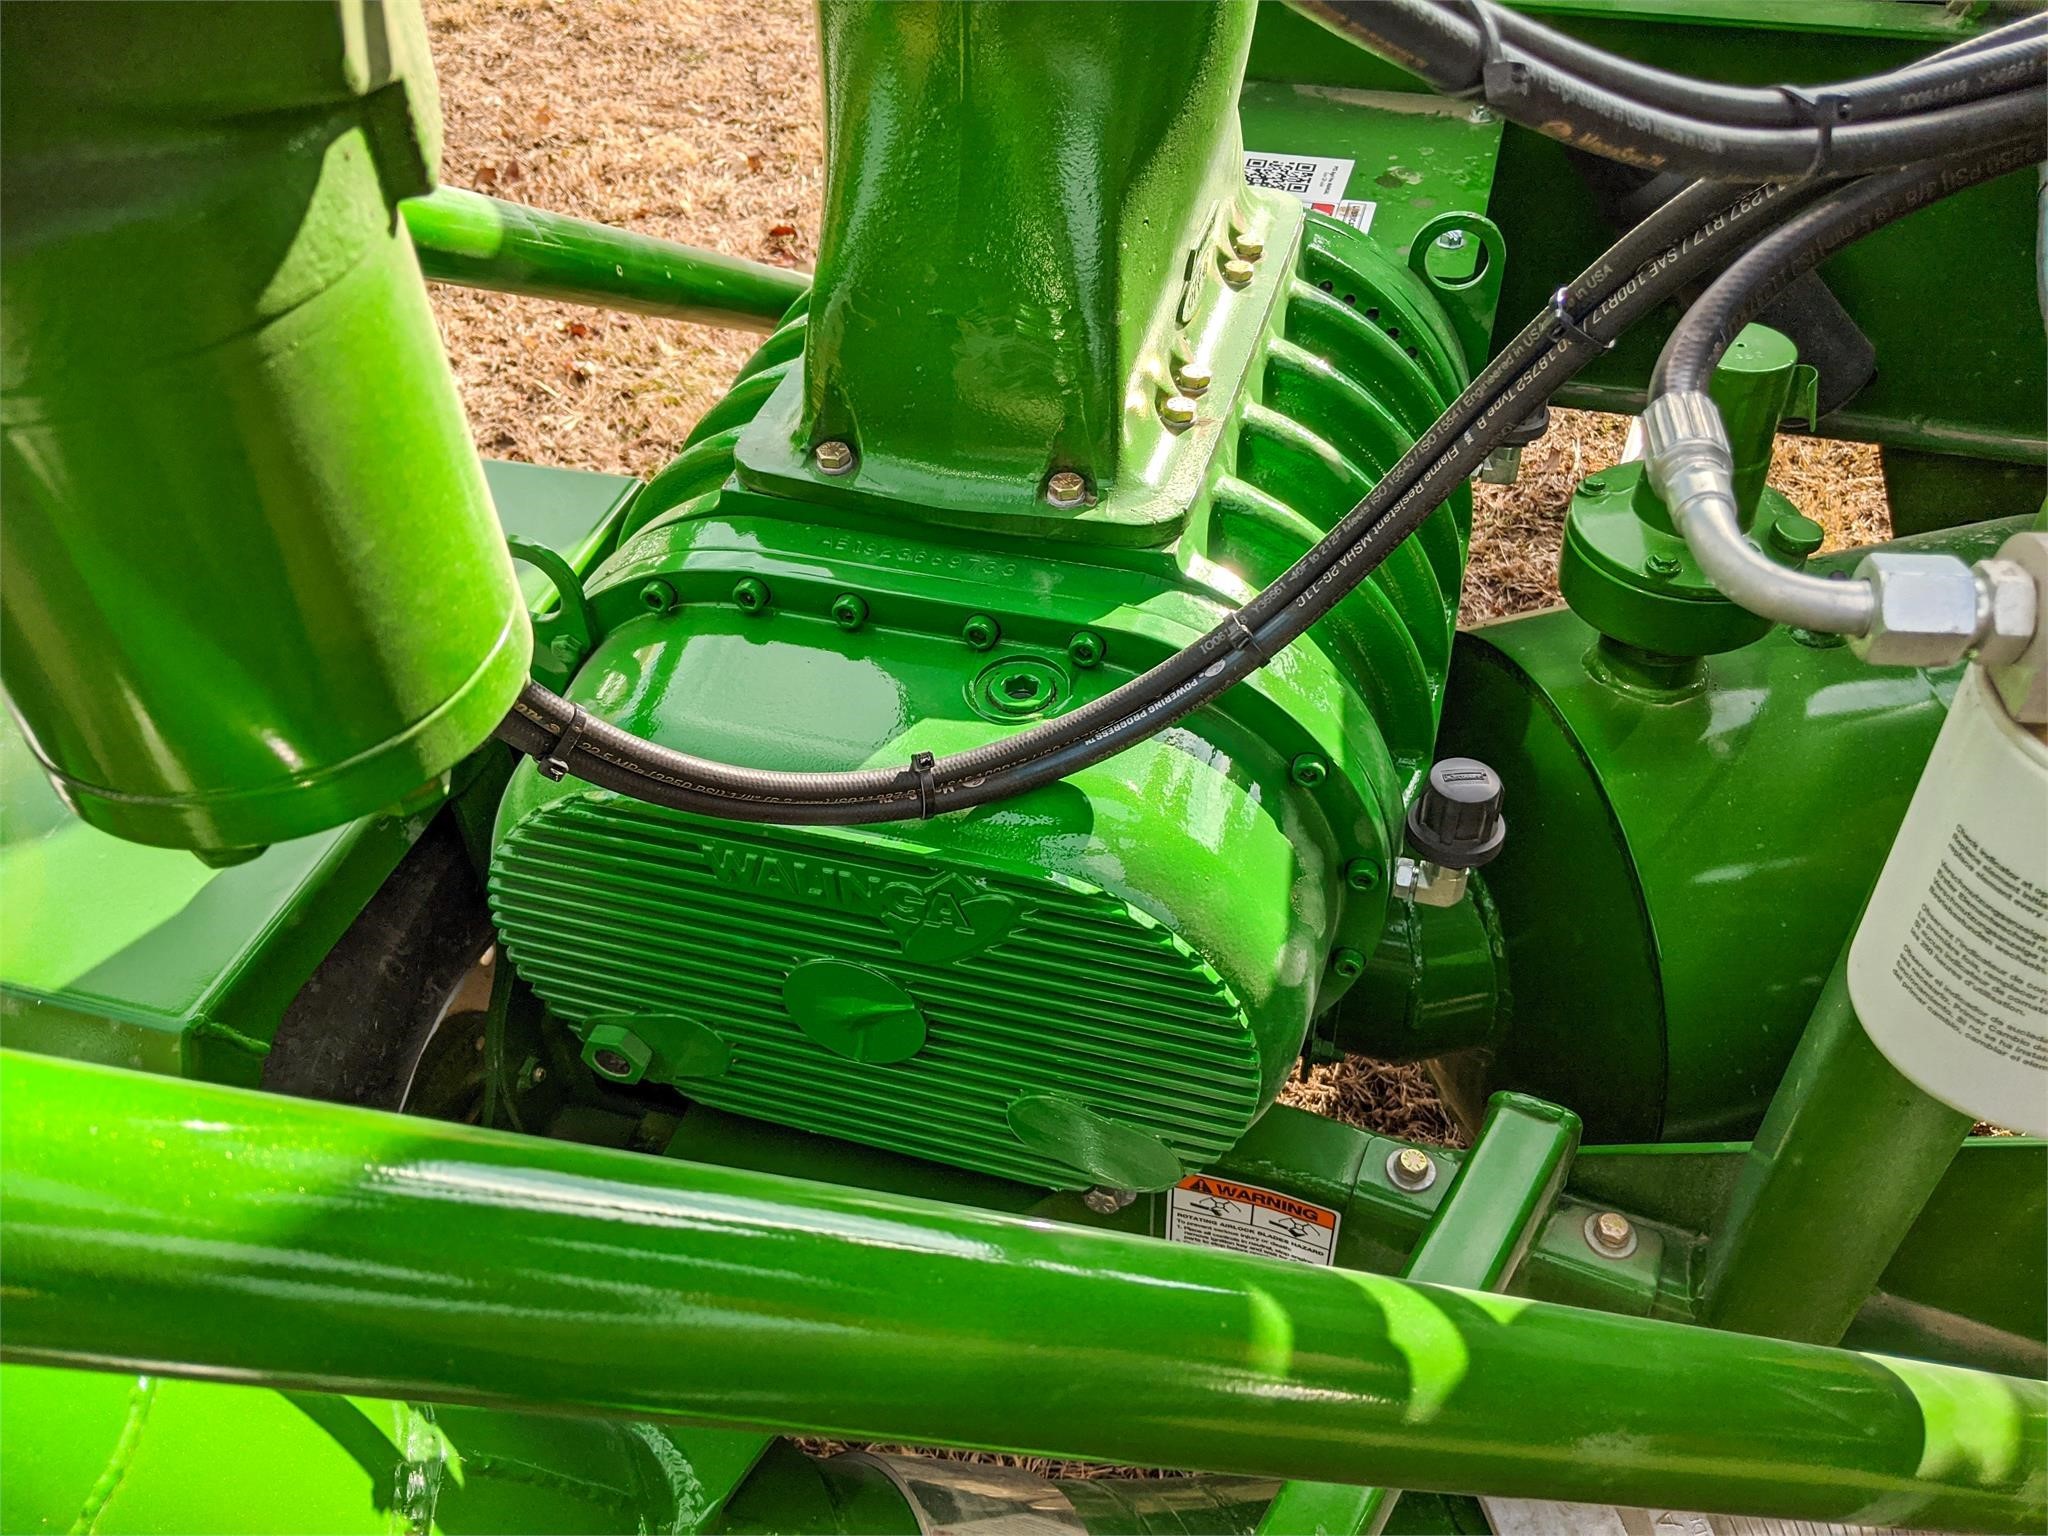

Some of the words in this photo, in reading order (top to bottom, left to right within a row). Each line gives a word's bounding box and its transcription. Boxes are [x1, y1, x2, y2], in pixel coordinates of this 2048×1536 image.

[1694, 216, 1725, 246] R17
[1584, 263, 1615, 291] USA
[1647, 247, 1680, 280] SAE
[1516, 349, 1558, 393] 18752
[1486, 381, 1523, 417] Type
[1475, 417, 1489, 431] B
[1308, 551, 1321, 564] to
[1318, 530, 1342, 554] 212F
[1369, 484, 1389, 505] ISO
[1416, 431, 1438, 457] ISO
[1463, 353, 1518, 409] Engineered
[1513, 344, 1525, 360] in
[1422, 446, 1460, 484] Flame
[1373, 480, 1427, 533] Resistant
[1338, 533, 1374, 569] MSHA
[1295, 563, 1340, 608] 2G-11C
[1146, 677, 1200, 714] POWERING
[1952, 832, 1982, 866] Replace
[1982, 865, 2021, 894] element
[1956, 823, 1979, 851] Check
[1979, 847, 2020, 881] indicator
[2020, 880, 2033, 890] at
[701, 844, 977, 936] WALINGA
[1948, 843, 1975, 873] replace
[1975, 871, 2013, 901] element
[2013, 898, 2044, 919] every
[1921, 902, 1955, 939] Observez
[2009, 973, 2024, 985] de
[1903, 943, 1935, 979] Observar
[1934, 978, 1944, 988] el
[1943, 985, 1989, 1018] indicador
[1989, 1015, 2005, 1027] de
[1933, 953, 1963, 981] heures
[1943, 951, 1991, 987] indicateur
[1991, 985, 2005, 997] de
[1982, 970, 2038, 1000] remplacer
[1901, 981, 1927, 1006] primer
[1963, 1032, 2009, 1057] cambiar
[2009, 1053, 2022, 1064] el
[1953, 1002, 1987, 1027] Primer
[1988, 1024, 2031, 1048] Cambio
[1967, 1024, 1982, 1035] no
[1983, 1032, 1997, 1043] se
[1998, 1039, 2014, 1050] ha
[1215, 1183, 1319, 1222] WARNING
[1176, 1212, 1218, 1227] ROTATING
[1219, 1221, 1256, 1236] AIRLOCK
[1257, 1230, 1290, 1245] BLADES
[1290, 1241, 1325, 1257] HAZARD
